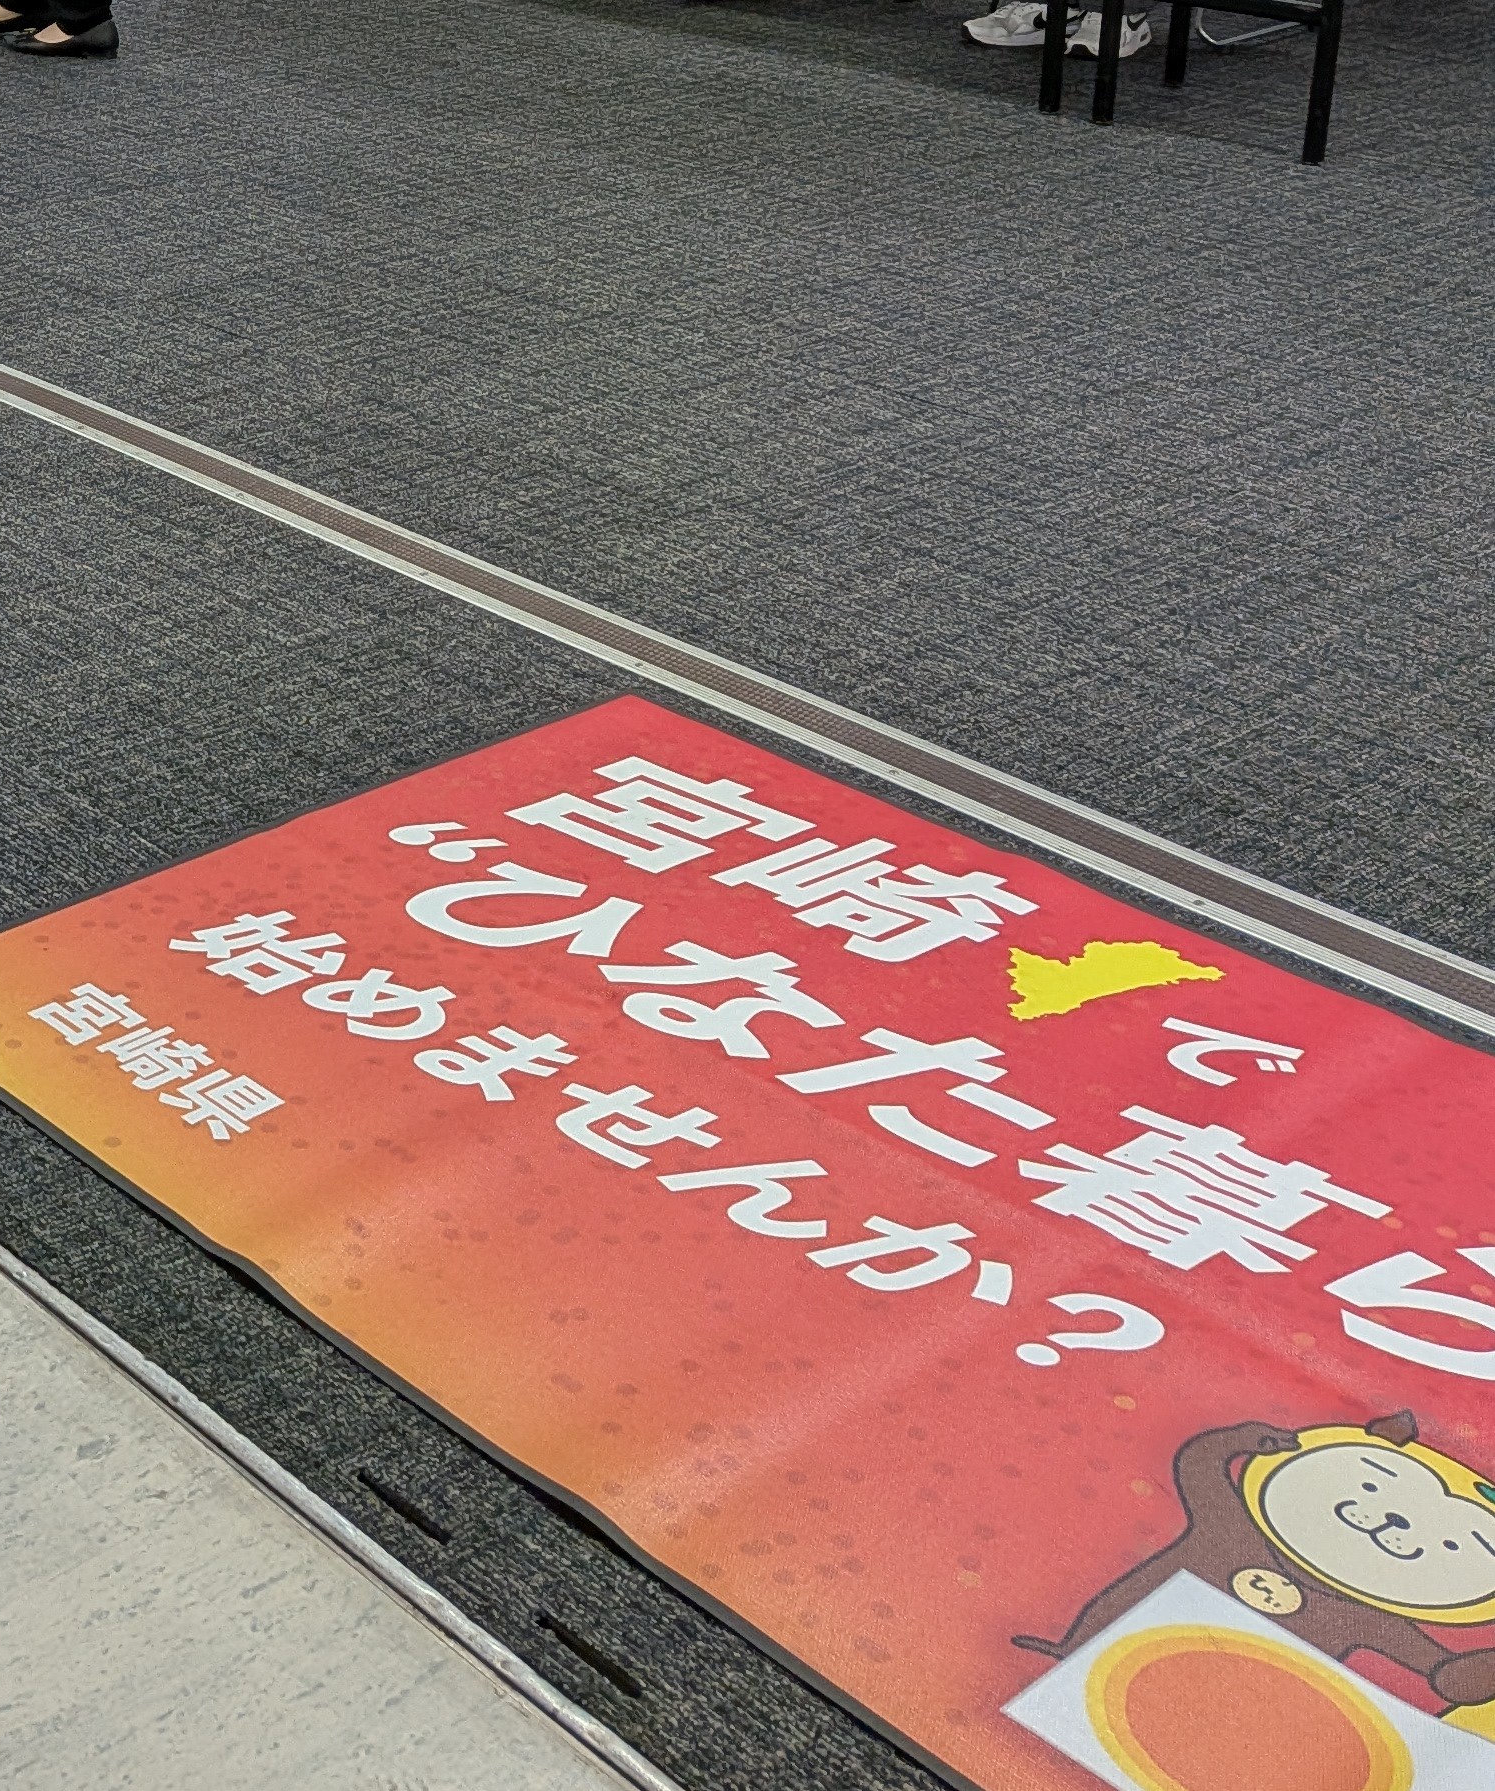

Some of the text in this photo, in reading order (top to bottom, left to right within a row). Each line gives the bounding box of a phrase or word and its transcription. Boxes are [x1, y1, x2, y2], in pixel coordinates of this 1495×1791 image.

[26, 981, 286, 1141] 宮崎県
[502, 755, 1305, 1088] 宮崎 で
[168, 909, 1164, 1367] 始めませんか?
